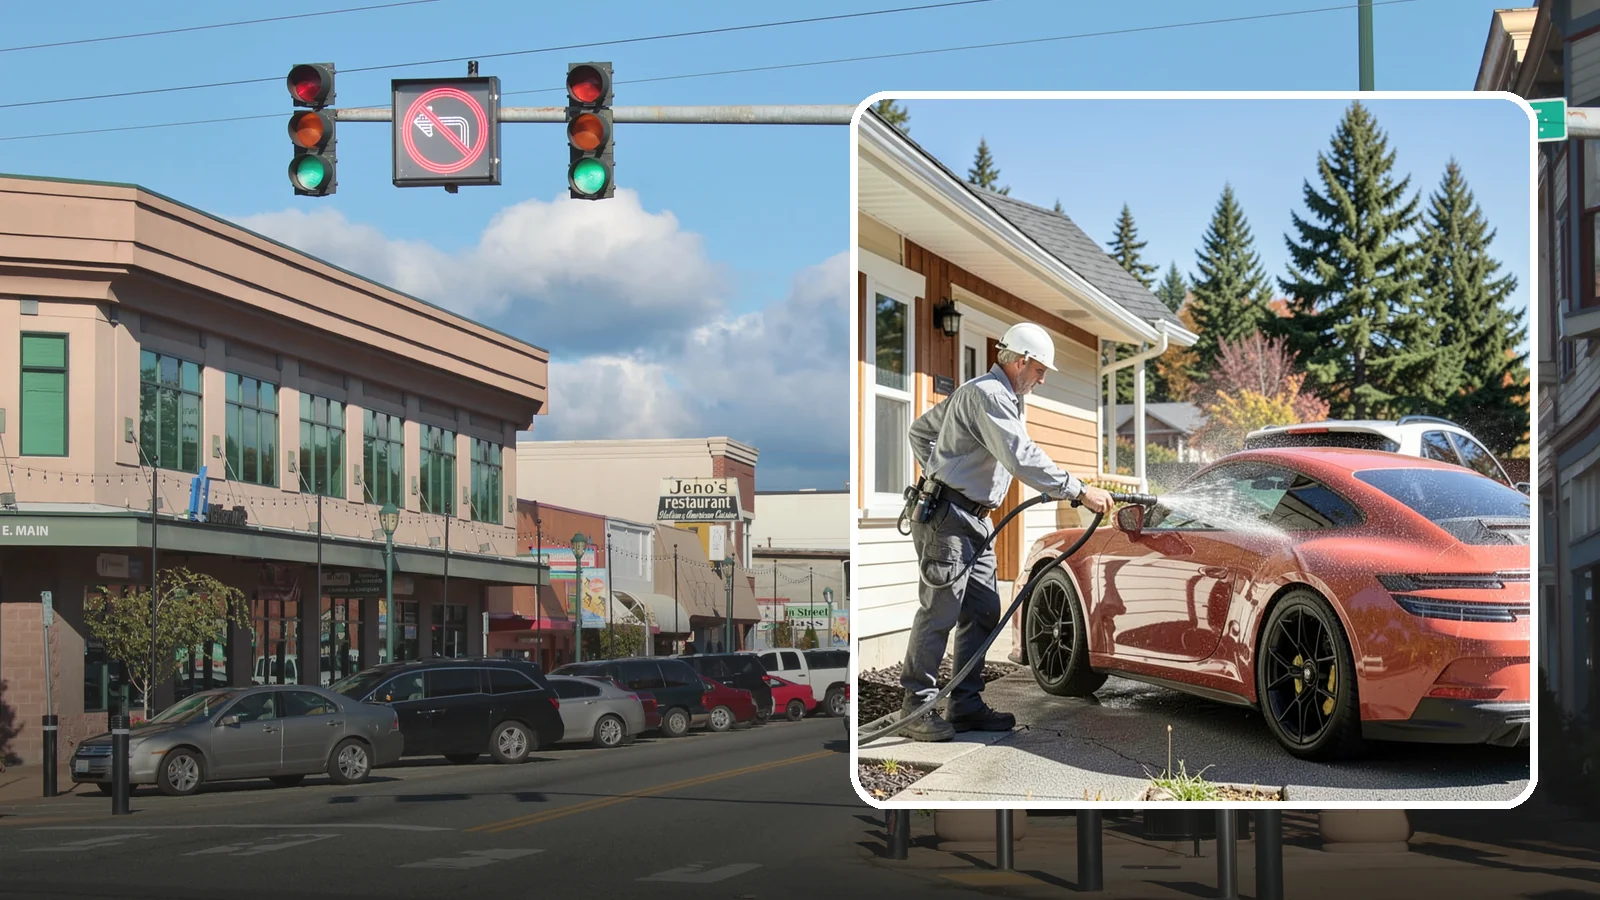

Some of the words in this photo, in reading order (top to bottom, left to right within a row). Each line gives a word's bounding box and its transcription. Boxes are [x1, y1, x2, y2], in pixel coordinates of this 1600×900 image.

[669, 479, 728, 495] Jeno's
[665, 496, 731, 509] restaurant
[659, 509, 681, 519] Italian
[686, 509, 715, 519] American
[715, 509, 738, 519] Cuisine
[2, 525, 13, 536] E.
[15, 525, 49, 536] MAIN
[797, 607, 828, 616] Street
